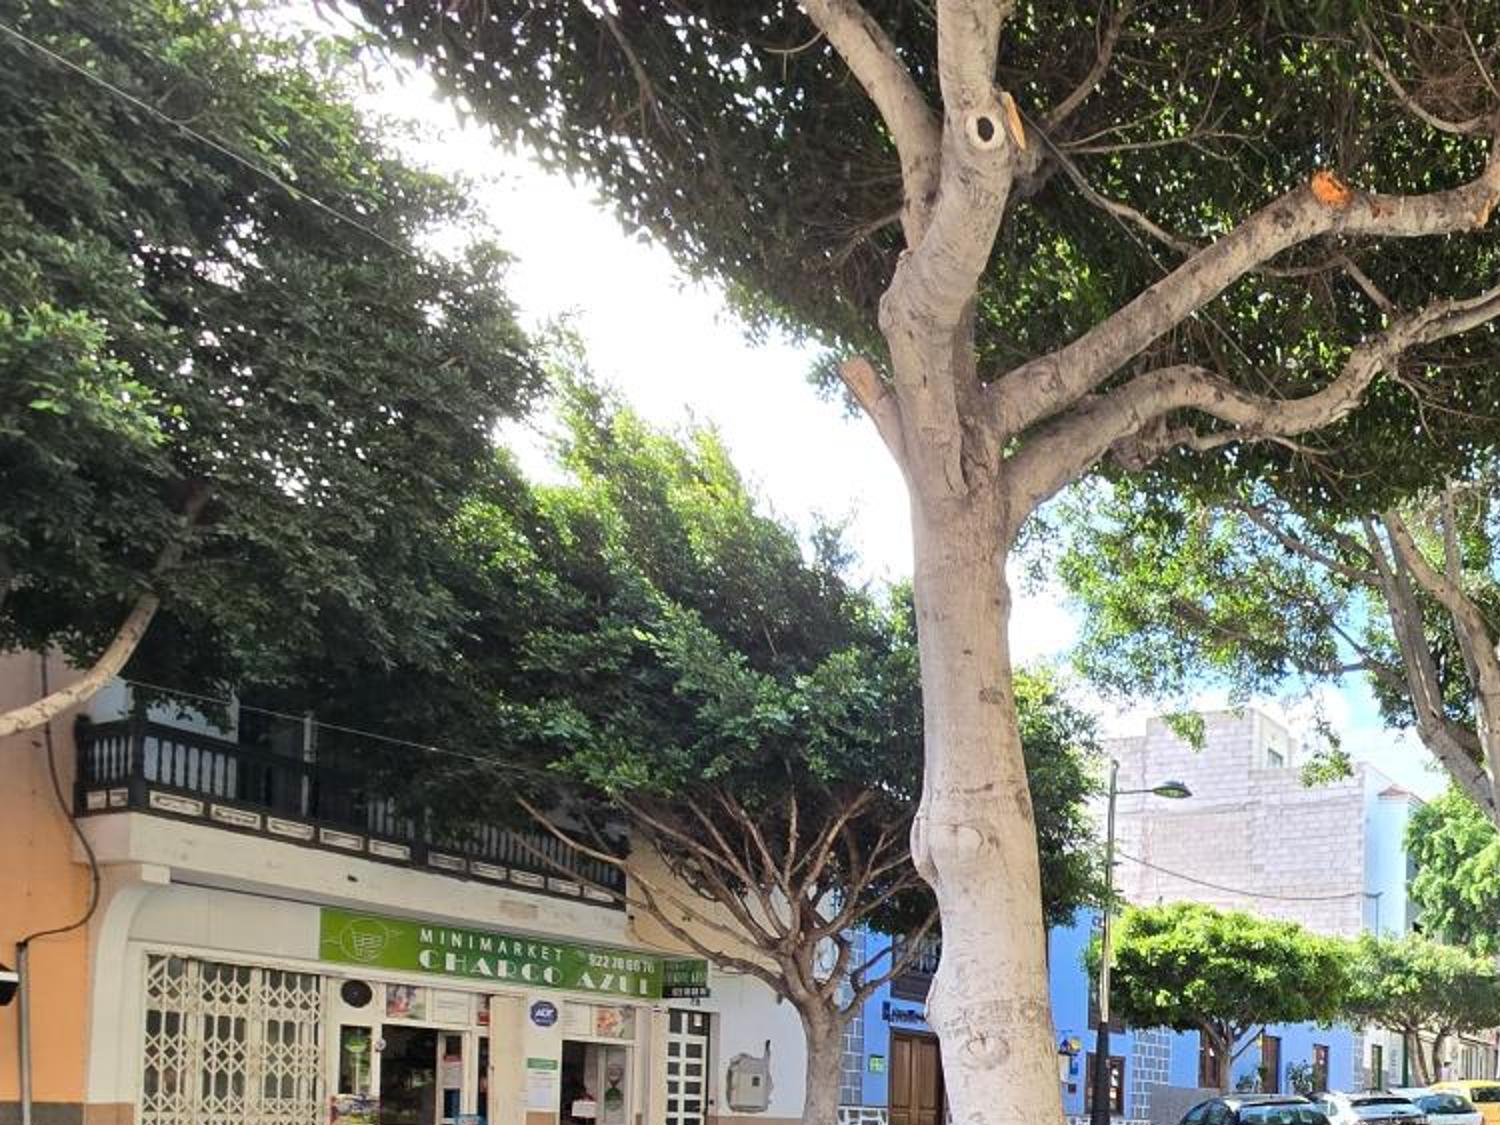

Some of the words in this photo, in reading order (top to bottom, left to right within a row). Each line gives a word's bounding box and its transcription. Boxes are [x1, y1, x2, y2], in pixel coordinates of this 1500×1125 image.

[420, 927, 564, 962] MINIMARKET
[419, 949, 564, 984] CHARCO
[576, 971, 648, 995] AZUL
